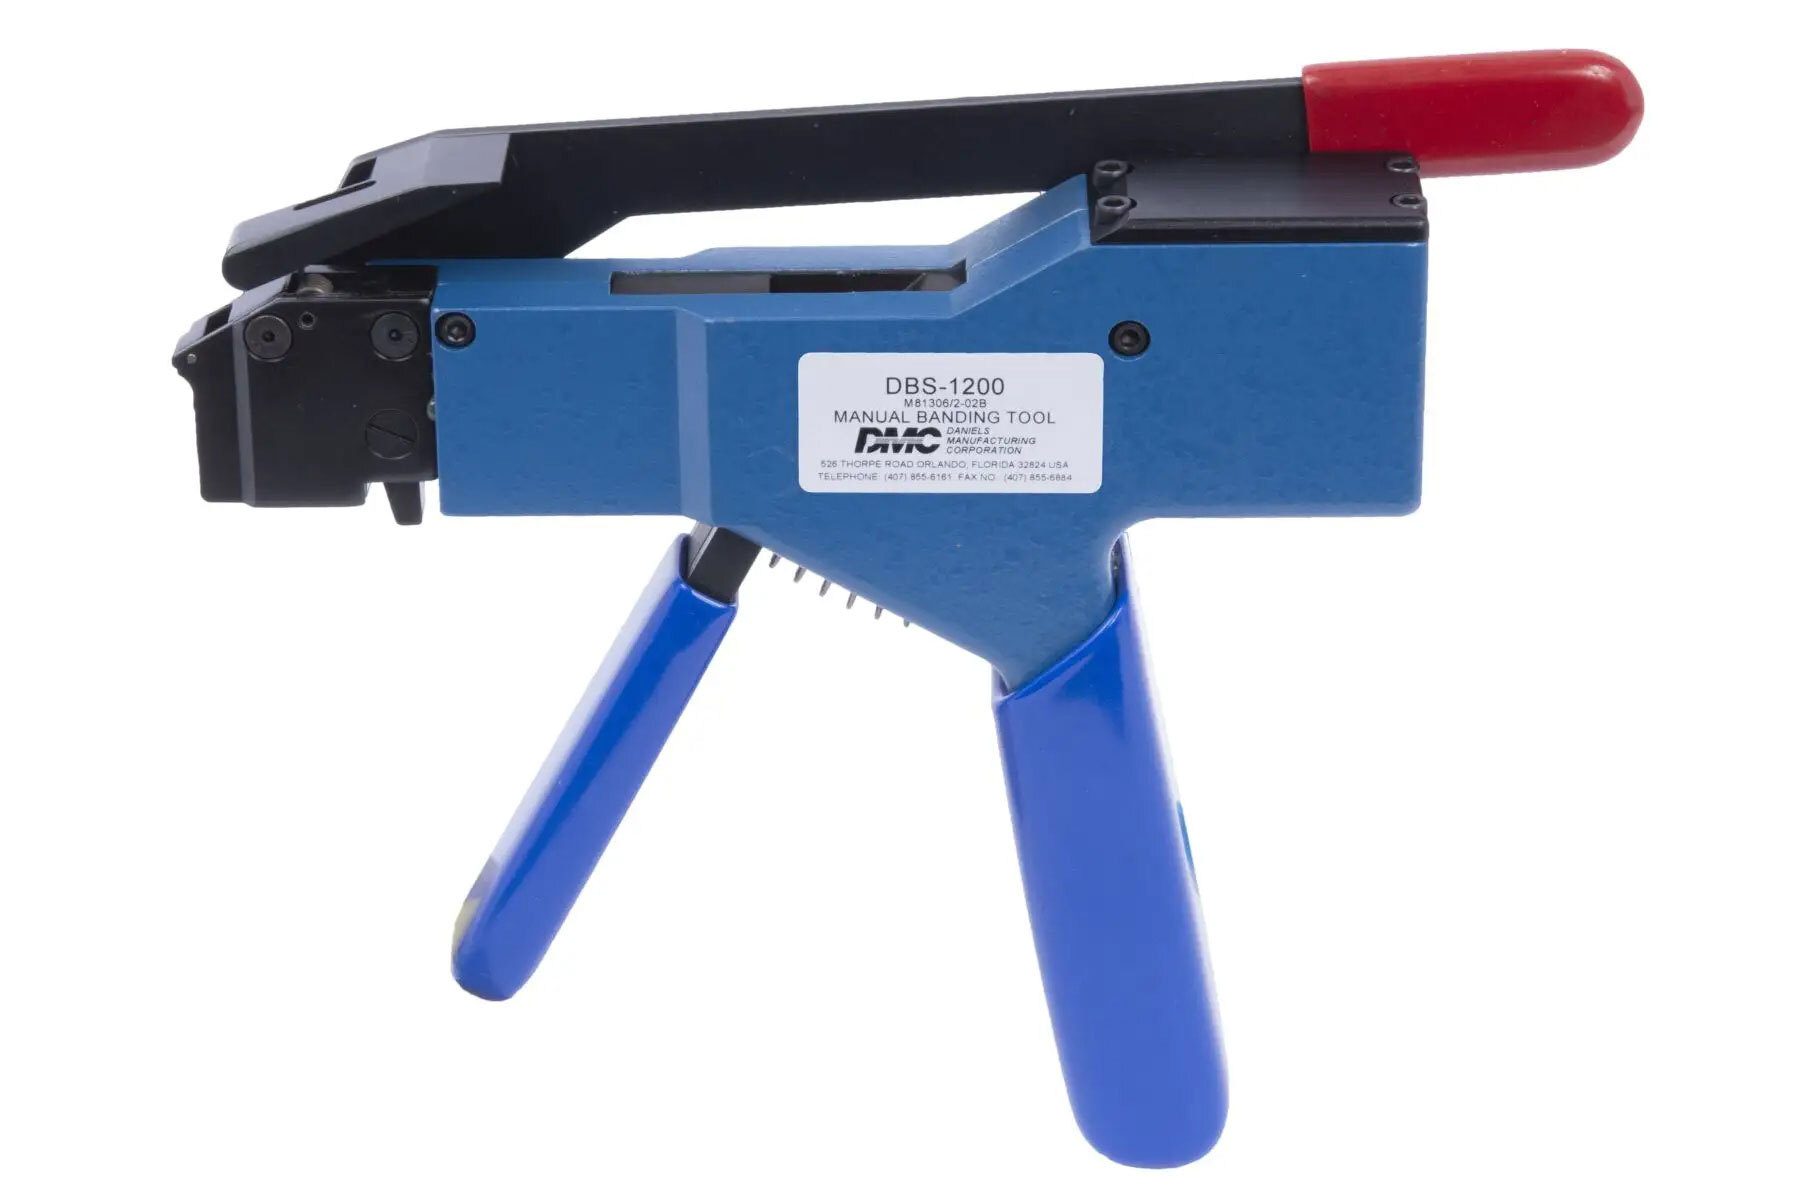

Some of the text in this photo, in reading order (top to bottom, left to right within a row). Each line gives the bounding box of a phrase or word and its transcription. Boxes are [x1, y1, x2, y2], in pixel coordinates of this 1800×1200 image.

[885, 376, 1005, 396] DBS-1200
[903, 398, 987, 408] M81306/2-02B
[834, 410, 1056, 424] MANUAL BANDING TOOL
[946, 426, 990, 436] DANIELS
[854, 426, 942, 454] DMC
[946, 436, 1036, 445] MANUFACTURING
[946, 446, 1022, 455] CORPORATION
[820, 460, 837, 469] 526
[841, 460, 881, 469] THORPE
[885, 460, 914, 469] ROAD
[972, 460, 1014, 469] FLORIDA
[1018, 461, 1045, 470] 32824
[1048, 461, 1069, 469] USA
[958, 473, 977, 481] FAX
